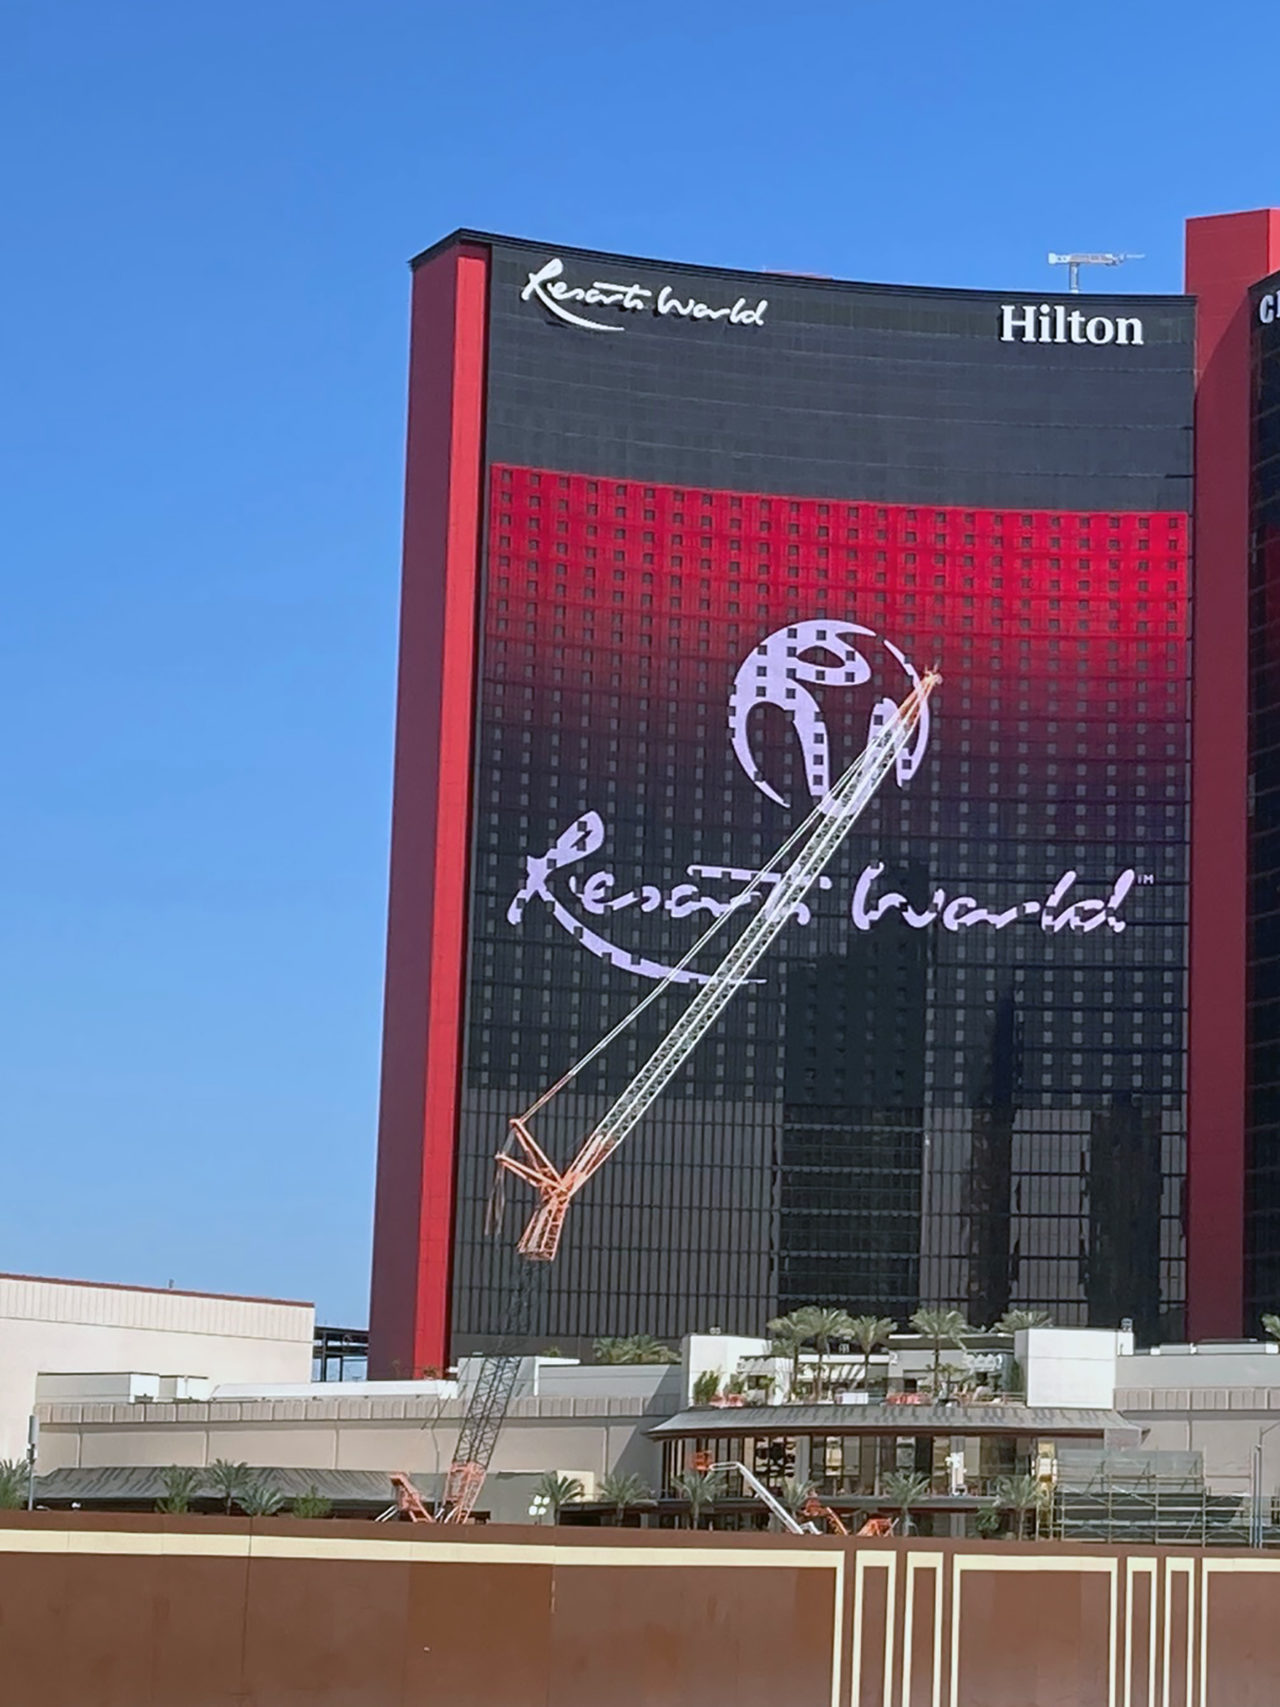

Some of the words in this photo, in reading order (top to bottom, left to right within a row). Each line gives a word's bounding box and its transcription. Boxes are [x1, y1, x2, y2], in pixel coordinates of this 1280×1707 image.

[521, 258, 652, 331] Resorts
[657, 285, 768, 326] World
[1000, 303, 1144, 345] Hilton
